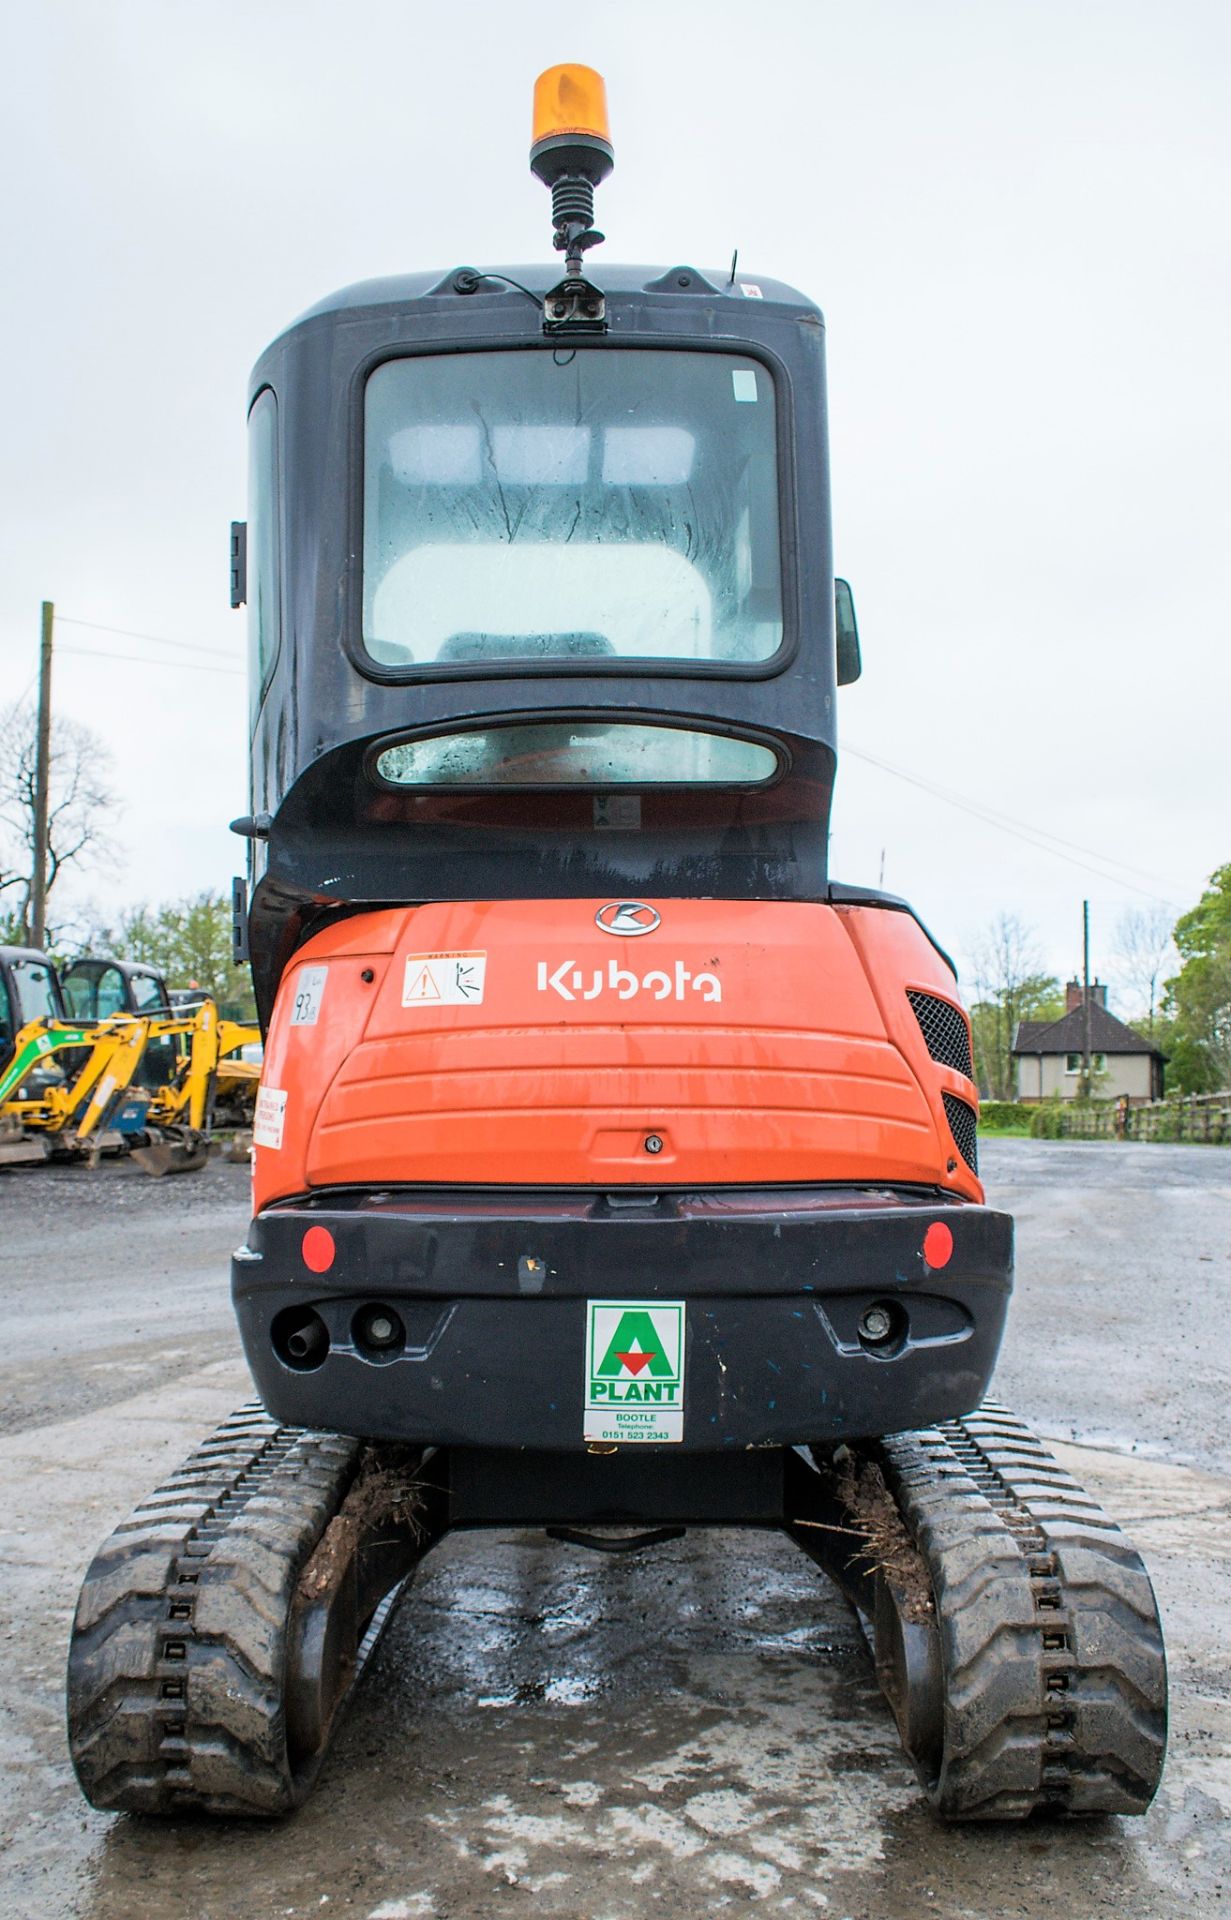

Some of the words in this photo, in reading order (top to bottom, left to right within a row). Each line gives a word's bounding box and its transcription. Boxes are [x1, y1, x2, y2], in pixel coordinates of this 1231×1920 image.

[427, 952, 469, 960] WARNING
[537, 959, 722, 1003] Kubota
[597, 1311, 674, 1377] A
[590, 1382, 680, 1401] PLANT
[616, 1413, 657, 1422] BOOTLE
[602, 1430, 624, 1439] 0151
[627, 1431, 644, 1440] 523
[647, 1432, 669, 1440] 2343
